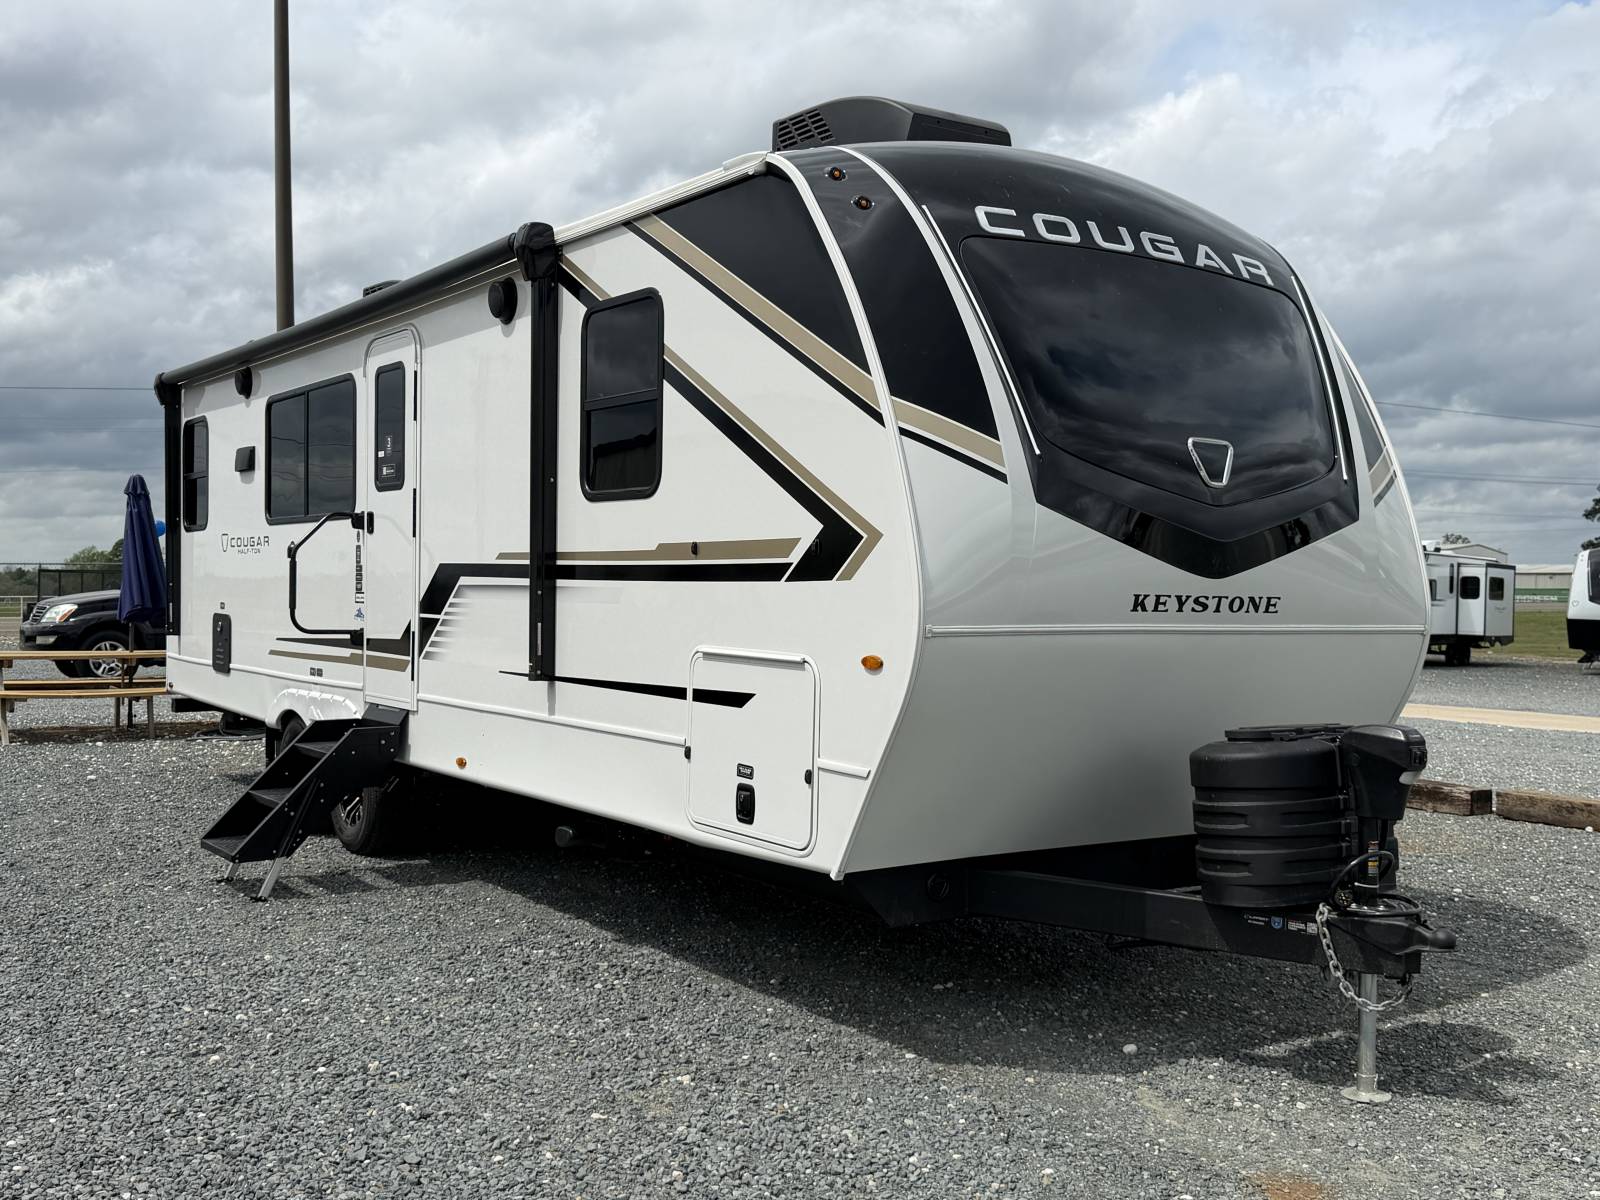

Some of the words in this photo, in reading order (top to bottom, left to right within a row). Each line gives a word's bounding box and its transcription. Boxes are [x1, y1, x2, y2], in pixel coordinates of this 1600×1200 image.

[974, 205, 1275, 287] COUGAR
[230, 535, 270, 548] COUGAR
[237, 547, 261, 555] HALF-TON
[1130, 593, 1282, 614] KEYSTONE
